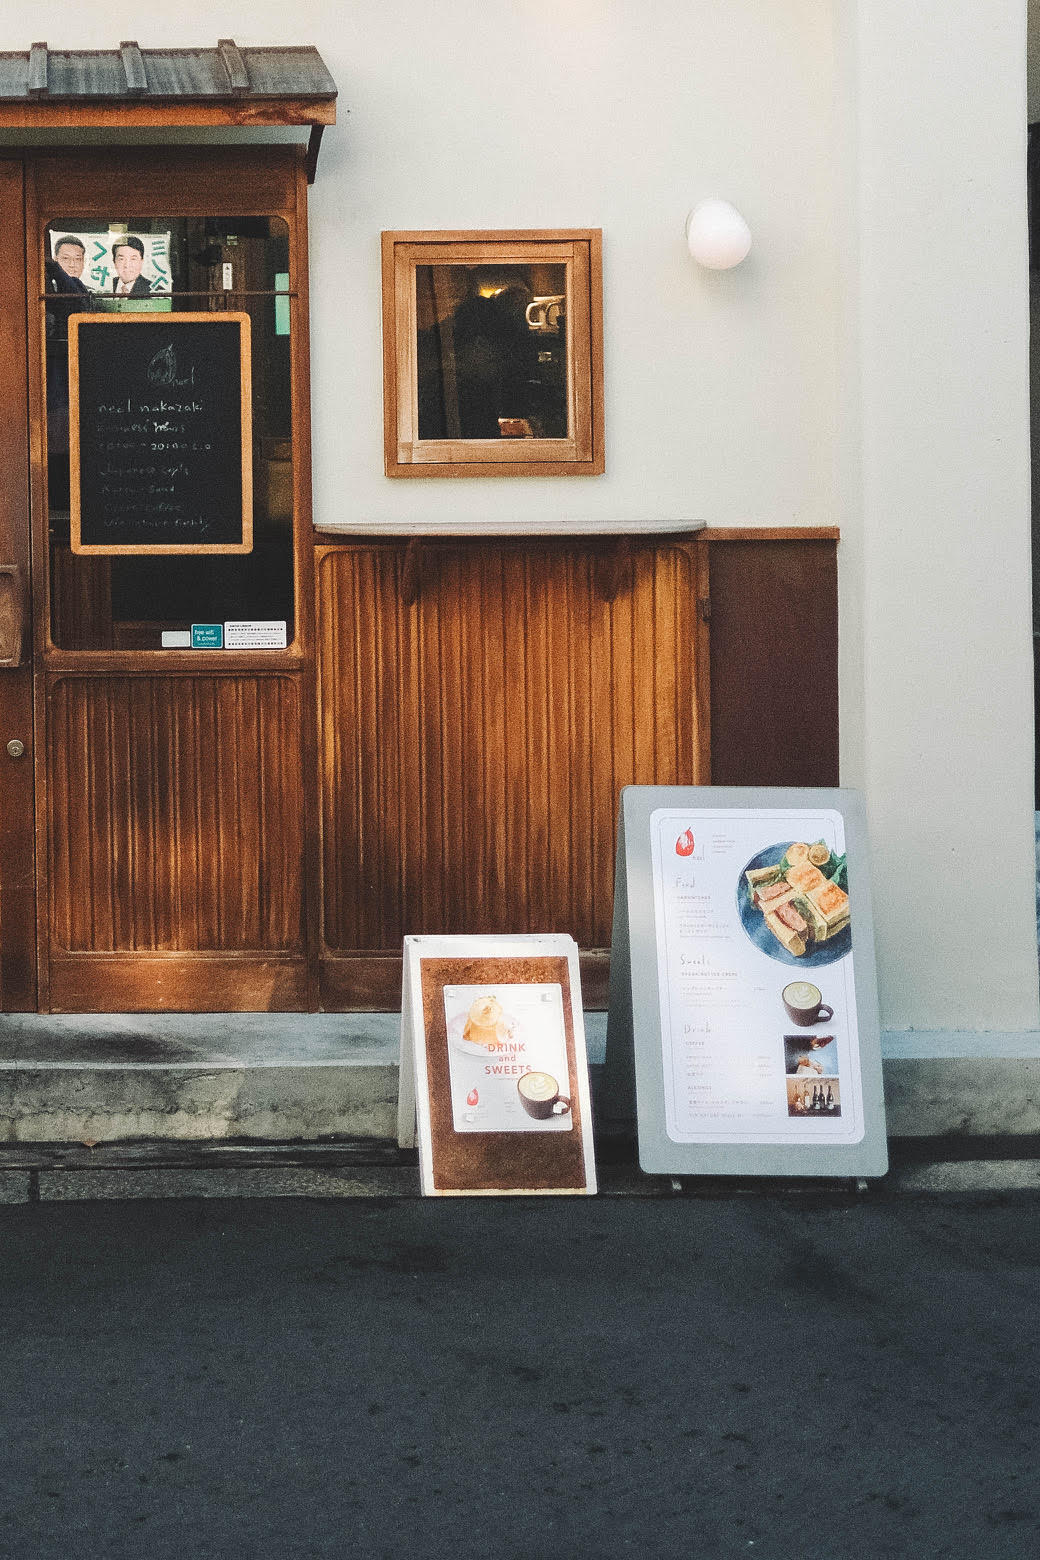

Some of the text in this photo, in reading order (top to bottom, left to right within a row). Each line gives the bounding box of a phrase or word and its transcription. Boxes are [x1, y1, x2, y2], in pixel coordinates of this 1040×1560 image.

[487, 1043, 526, 1053] DRINK
[498, 1054, 517, 1062] and
[484, 1064, 533, 1075] SWEETS
